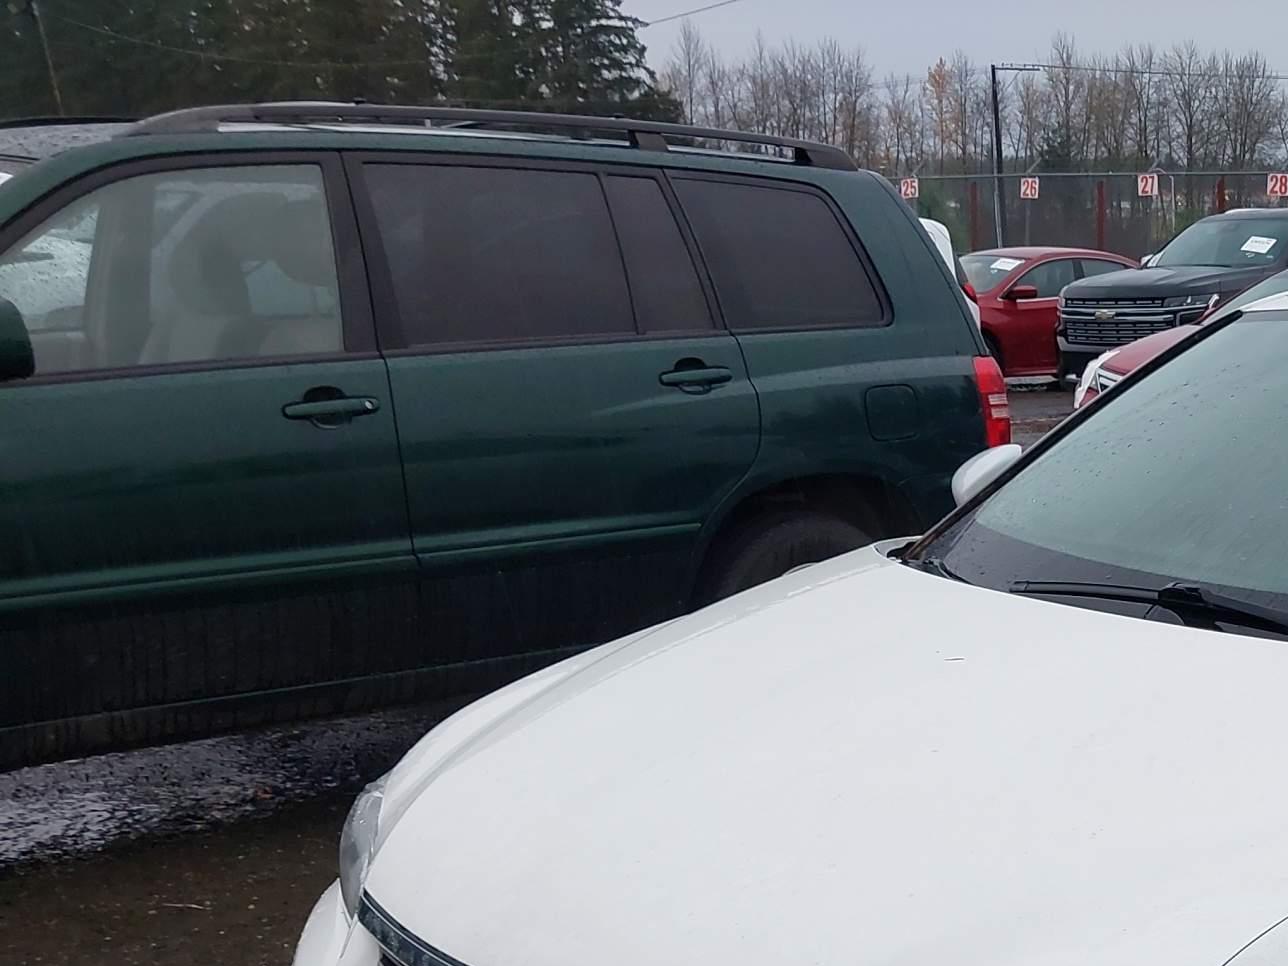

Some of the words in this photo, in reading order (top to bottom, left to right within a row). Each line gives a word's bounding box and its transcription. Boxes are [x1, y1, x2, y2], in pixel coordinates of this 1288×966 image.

[902, 179, 917, 197] 25
[1022, 179, 1038, 198] 26
[1140, 175, 1155, 194] 27
[1269, 175, 1288, 194] 28
